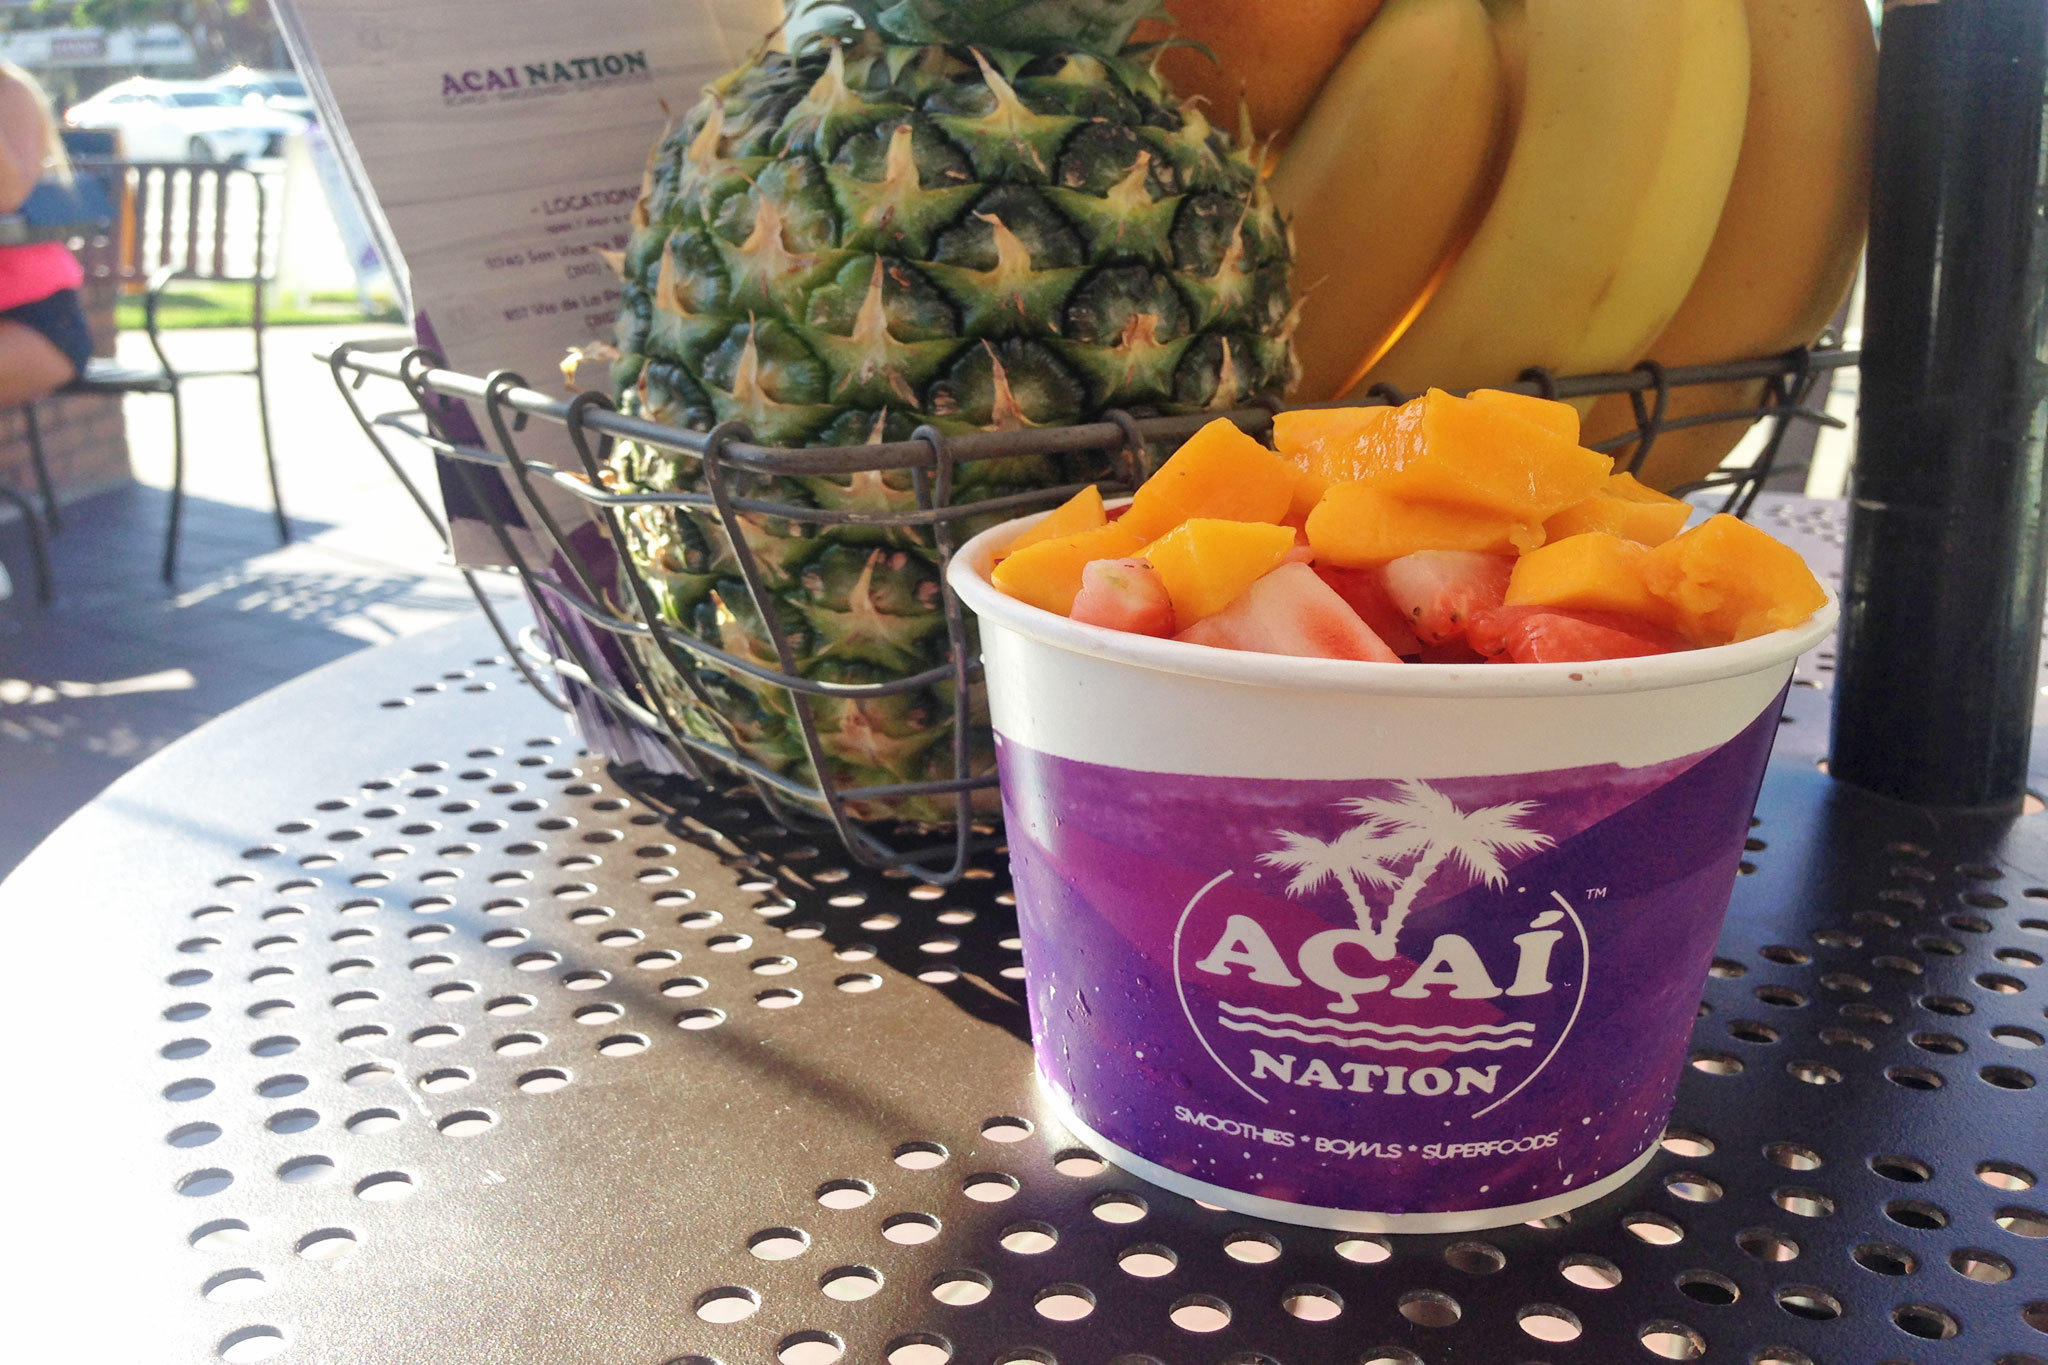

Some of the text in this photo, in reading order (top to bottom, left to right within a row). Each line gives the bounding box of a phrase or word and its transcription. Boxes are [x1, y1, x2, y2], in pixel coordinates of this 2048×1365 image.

[443, 67, 519, 97] ACAI
[523, 51, 647, 86] NATION
[1585, 886, 1608, 900] TM
[1250, 1049, 1501, 1096] NATION
[1174, 1105, 1559, 1160] SMOOTHIES BOWLS SUPERFOODS
